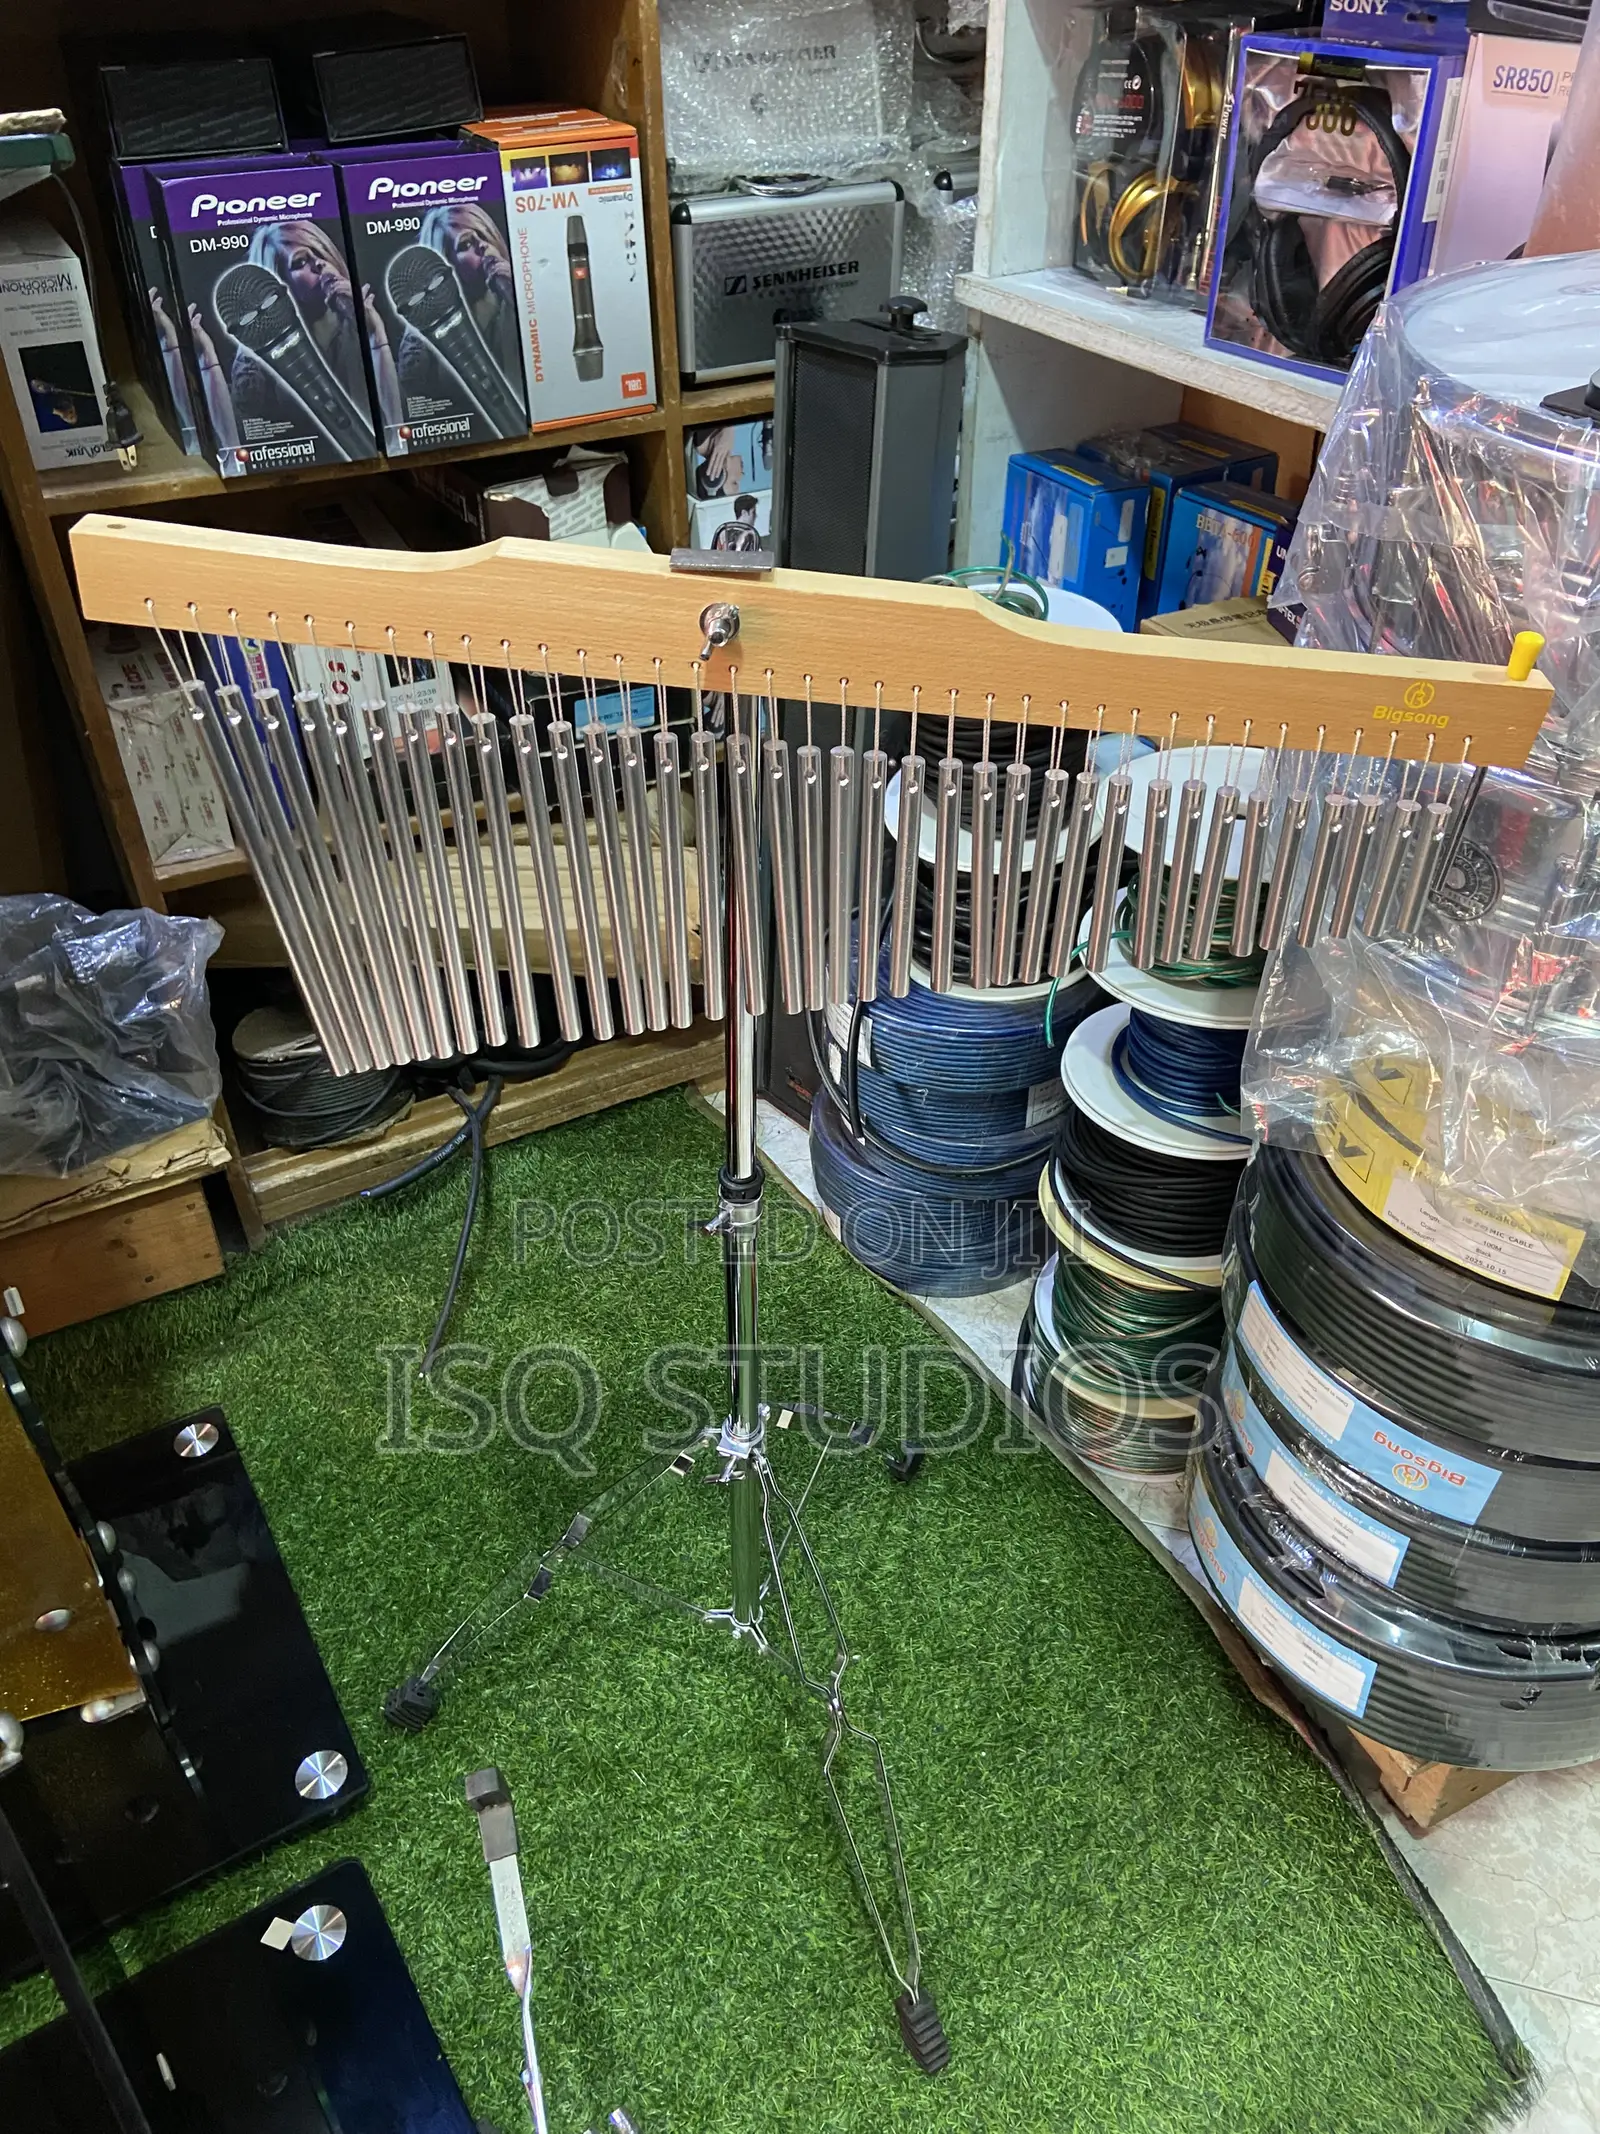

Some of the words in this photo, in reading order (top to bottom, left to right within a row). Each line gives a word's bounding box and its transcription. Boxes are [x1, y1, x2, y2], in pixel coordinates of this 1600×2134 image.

[1329, 0, 1389, 15] SONY
[1492, 64, 1554, 94] SR850
[367, 176, 489, 200] Pioneer
[598, 193, 633, 204] Dynamic
[190, 192, 322, 218] Pioneer
[425, 198, 448, 207] Dynamic
[448, 195, 479, 204] Microphone
[515, 191, 580, 213] VM-70S
[217, 216, 253, 227] Professional
[253, 214, 278, 224] Dynamic
[278, 212, 313, 221] Microphone
[366, 217, 421, 235] DM-990
[189, 234, 250, 253] DM-990
[517, 227, 537, 315] MICROPHONE
[753, 260, 860, 289] SENNHEISER
[528, 318, 545, 383] DYNAMIC
[1372, 705, 1450, 729] Bigsong
[1488, 1228, 1505, 1240] MIC
[1508, 1235, 1535, 1250] CABLE
[1465, 1255, 1508, 1275] 2025.10.15
[1372, 1429, 1467, 1487] Bigsong
[1326, 1496, 1365, 1527] speaker
[1368, 1525, 1397, 1545] cable
[1295, 1621, 1333, 1651] speaker
[1335, 1650, 1364, 1670] cable
